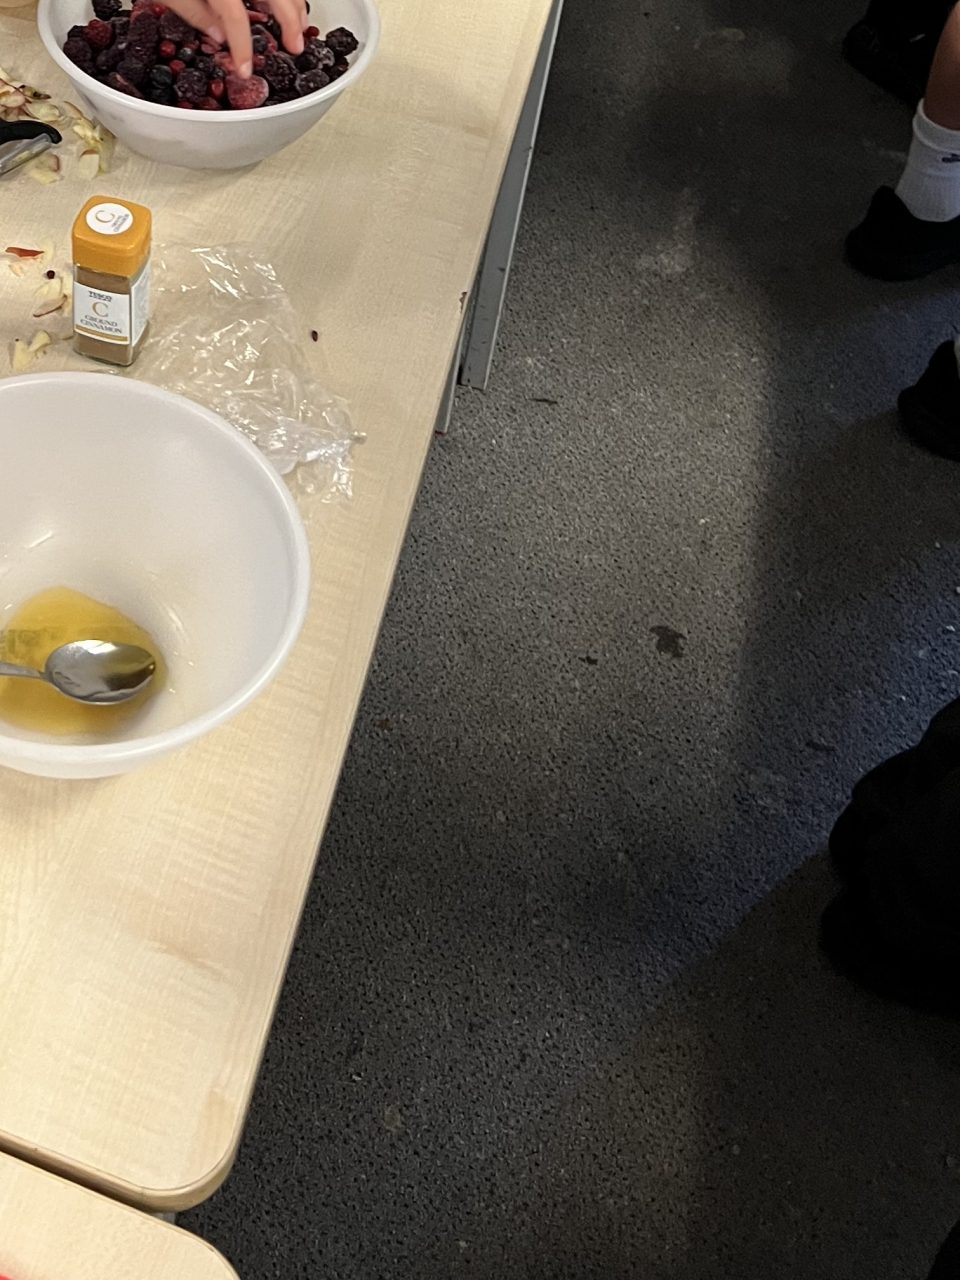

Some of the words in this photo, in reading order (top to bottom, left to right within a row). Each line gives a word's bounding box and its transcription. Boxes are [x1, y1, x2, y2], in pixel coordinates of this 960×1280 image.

[92, 301, 109, 318] C
[80, 319, 122, 333] CINNAMON
[84, 315, 118, 327] GROUND
